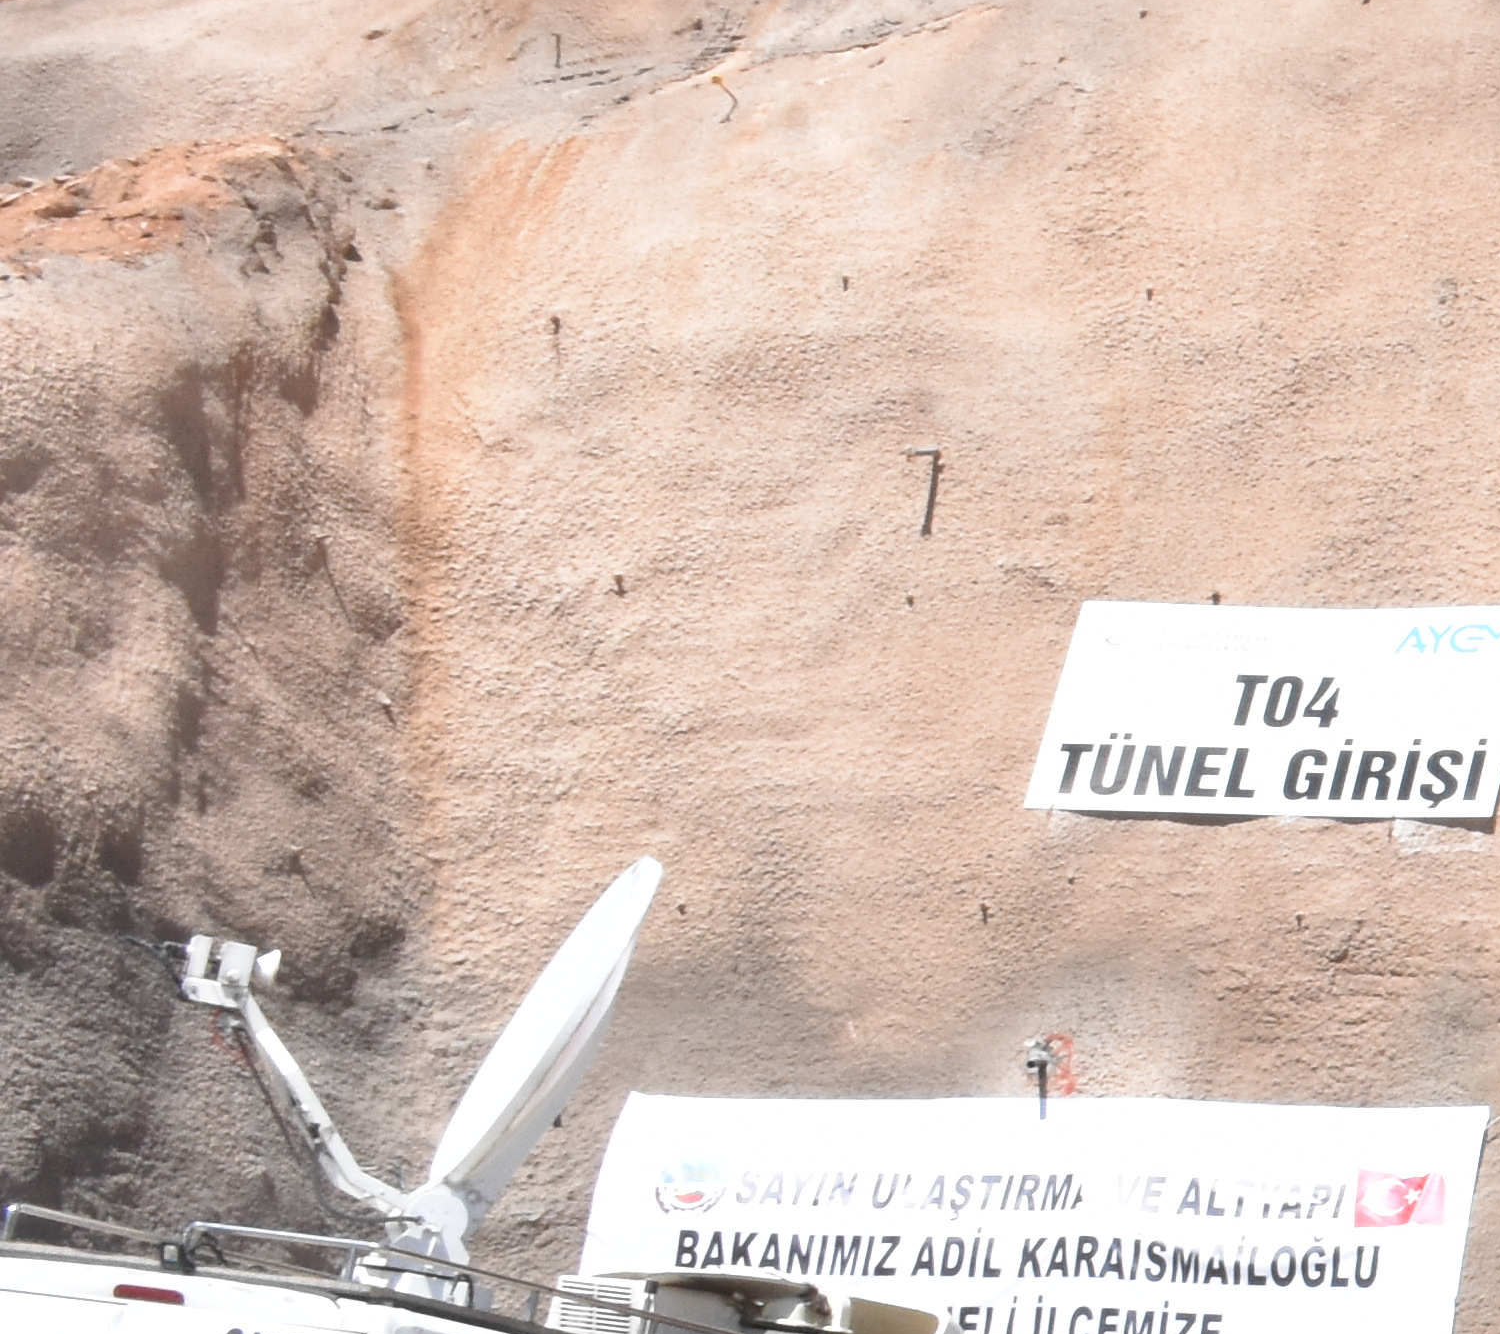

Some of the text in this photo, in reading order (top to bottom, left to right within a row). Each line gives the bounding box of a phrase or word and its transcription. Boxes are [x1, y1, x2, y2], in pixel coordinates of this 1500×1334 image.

[1234, 674, 1339, 728] T04
[1058, 733, 1488, 809] TÜNEL GİRİŞİ
[736, 1169, 857, 1206] SAYIN
[674, 1229, 901, 1276] BAKANIMIZ
[911, 1227, 1002, 1277] ADİL
